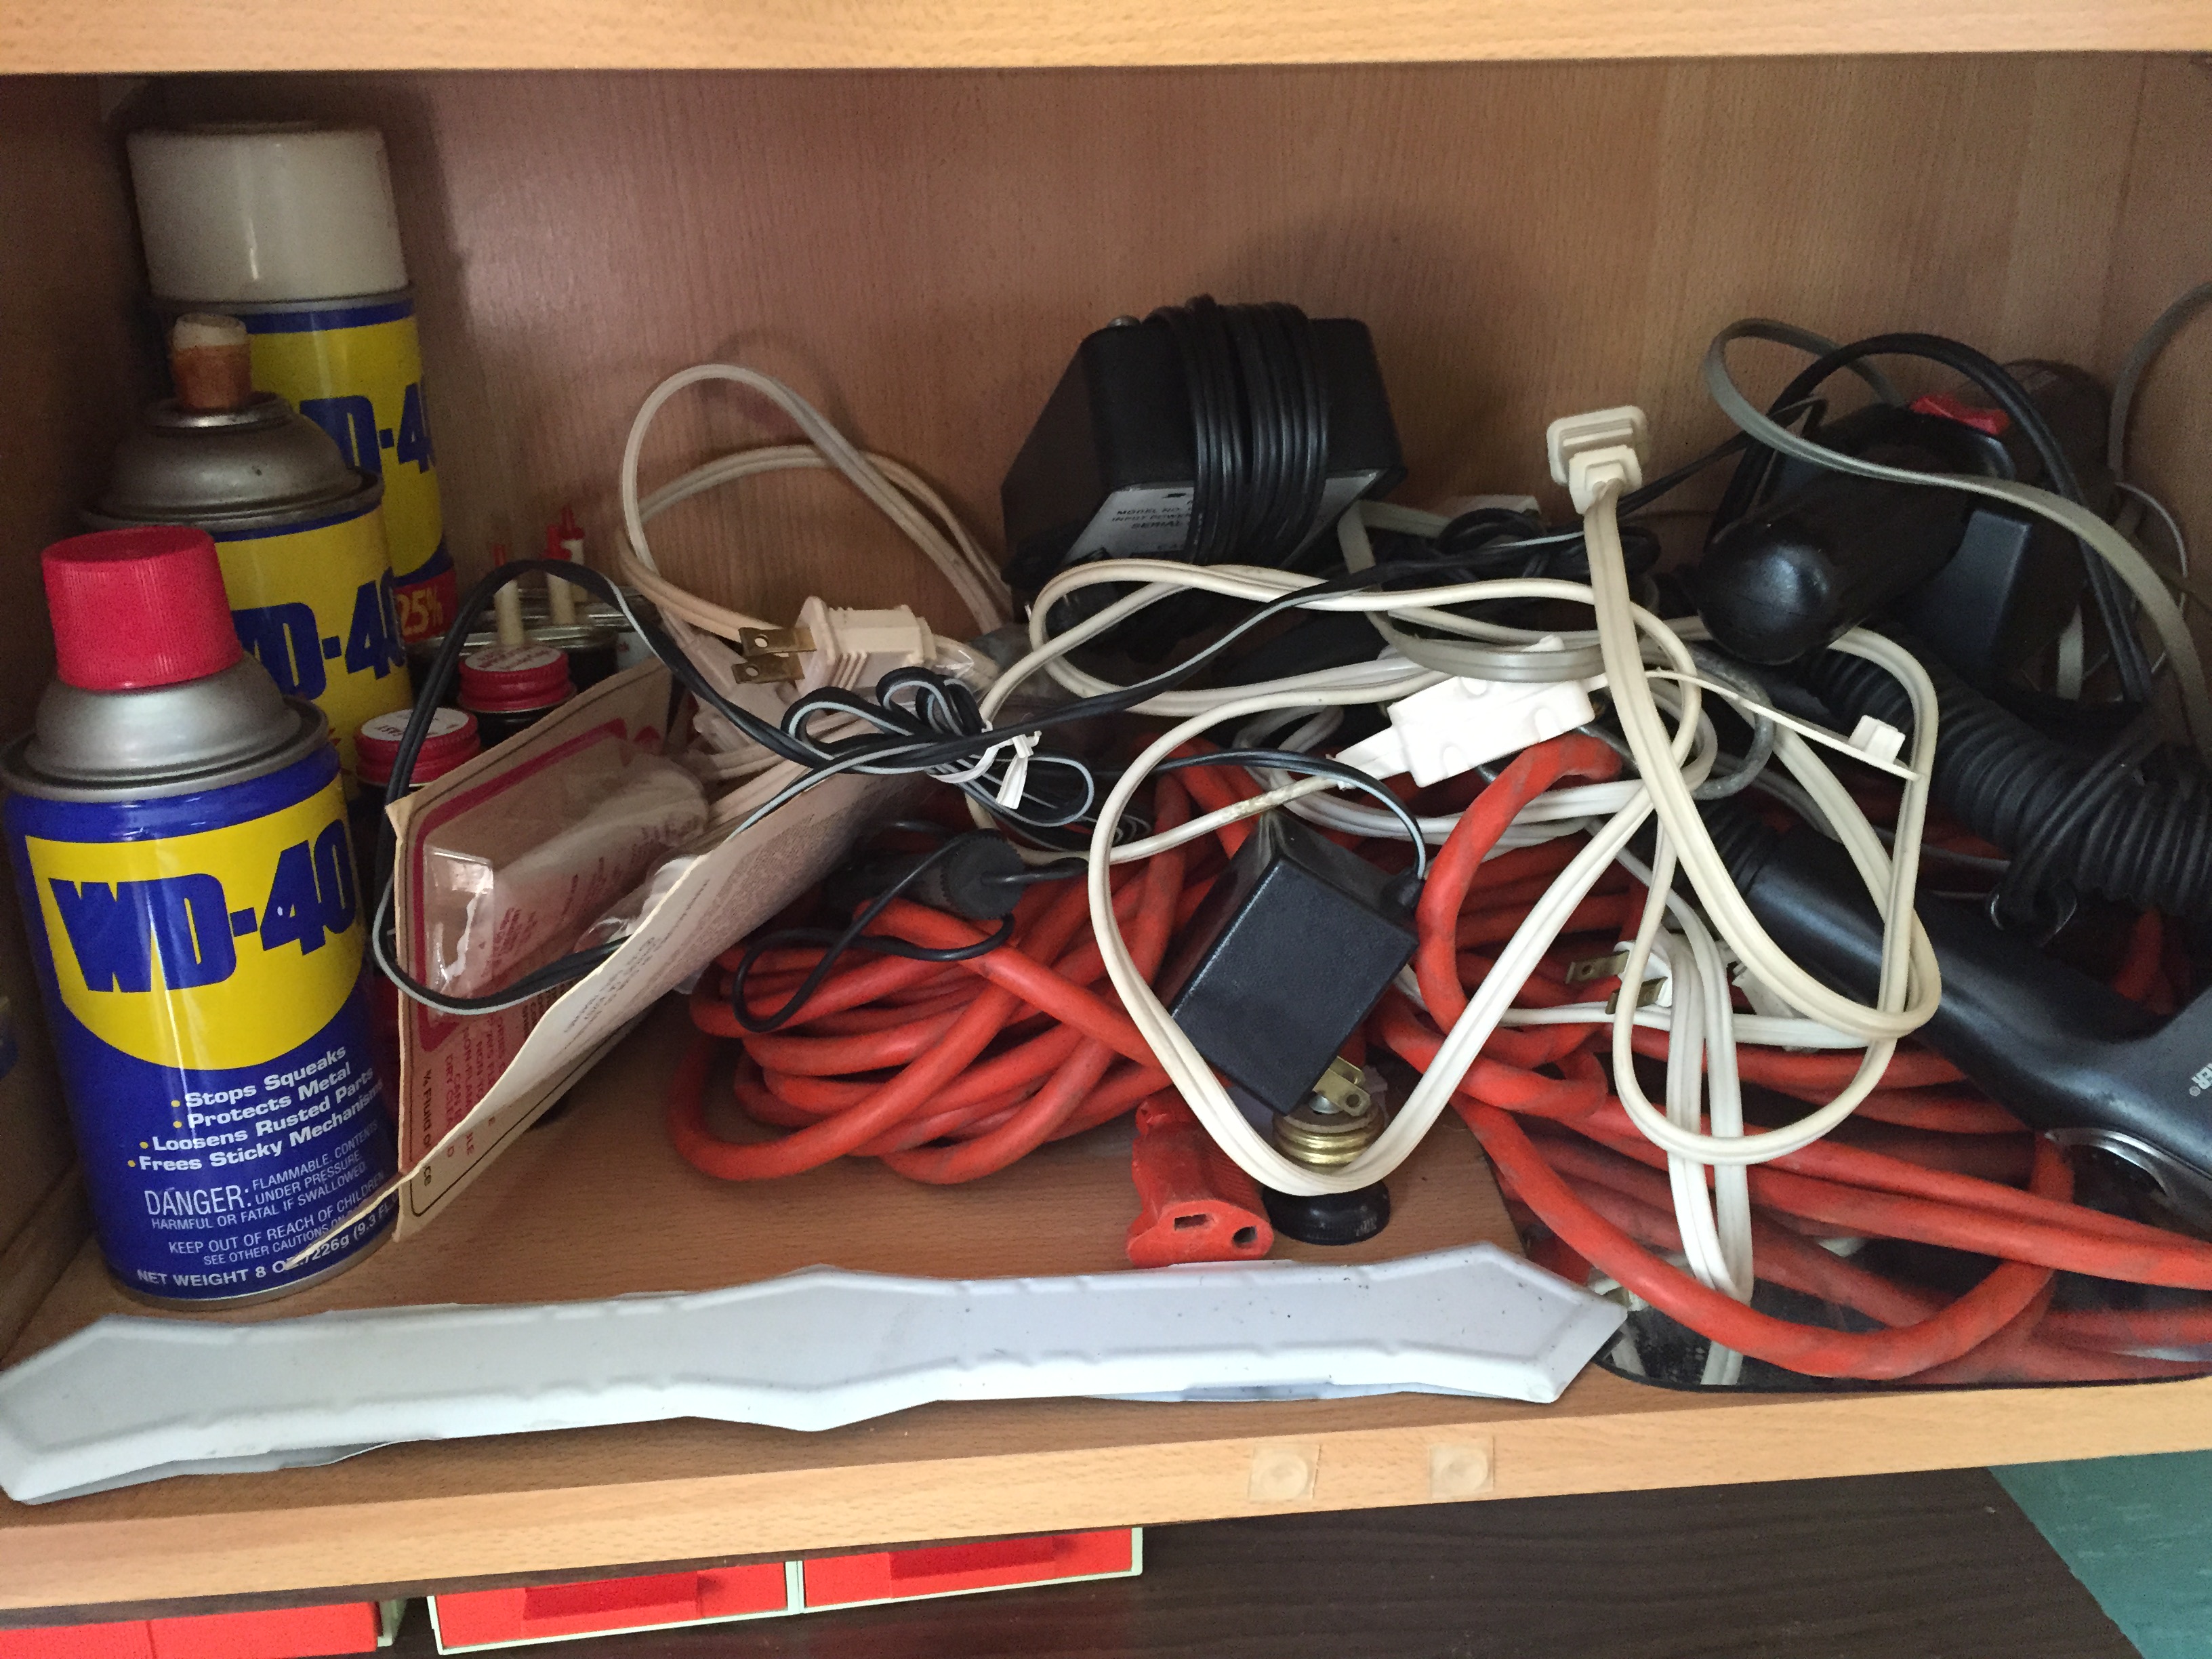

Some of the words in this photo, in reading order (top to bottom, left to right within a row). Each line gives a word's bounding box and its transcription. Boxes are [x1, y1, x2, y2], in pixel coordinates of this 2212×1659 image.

[49, 818, 356, 993] WD-40
[185, 1085, 257, 1107] Stops
[264, 1046, 346, 1091] Squeaks
[187, 1095, 291, 1128] Protects
[298, 1061, 350, 1101] Metal
[152, 1130, 248, 1151] Loosens
[255, 1096, 331, 1136] Rusted
[335, 1067, 373, 1104] Parts
[139, 1155, 202, 1171] Frees
[209, 1140, 282, 1167] Sticky
[252, 1153, 333, 1191] FLAMMABLE.
[144, 1185, 251, 1216] DANGER:
[152, 1218, 213, 1230] HARMFUL
[217, 1214, 237, 1227] OR
[241, 1206, 280, 1223] FATAL
[283, 1199, 295, 1211] IF
[255, 1185, 301, 1205] UNDER
[169, 1241, 203, 1254] KEEP
[208, 1236, 239, 1252] OUT
[243, 1231, 262, 1247] OF
[267, 1214, 314, 1242] REACH
[318, 1204, 333, 1223] OF
[204, 1255, 226, 1265] SEE
[229, 1246, 270, 1263] OTHER
[272, 1224, 329, 1252] CAUTIONS
[137, 1269, 167, 1285] NET
[173, 1269, 249, 1286] WEIGHT
[255, 1266, 267, 1278] 8
